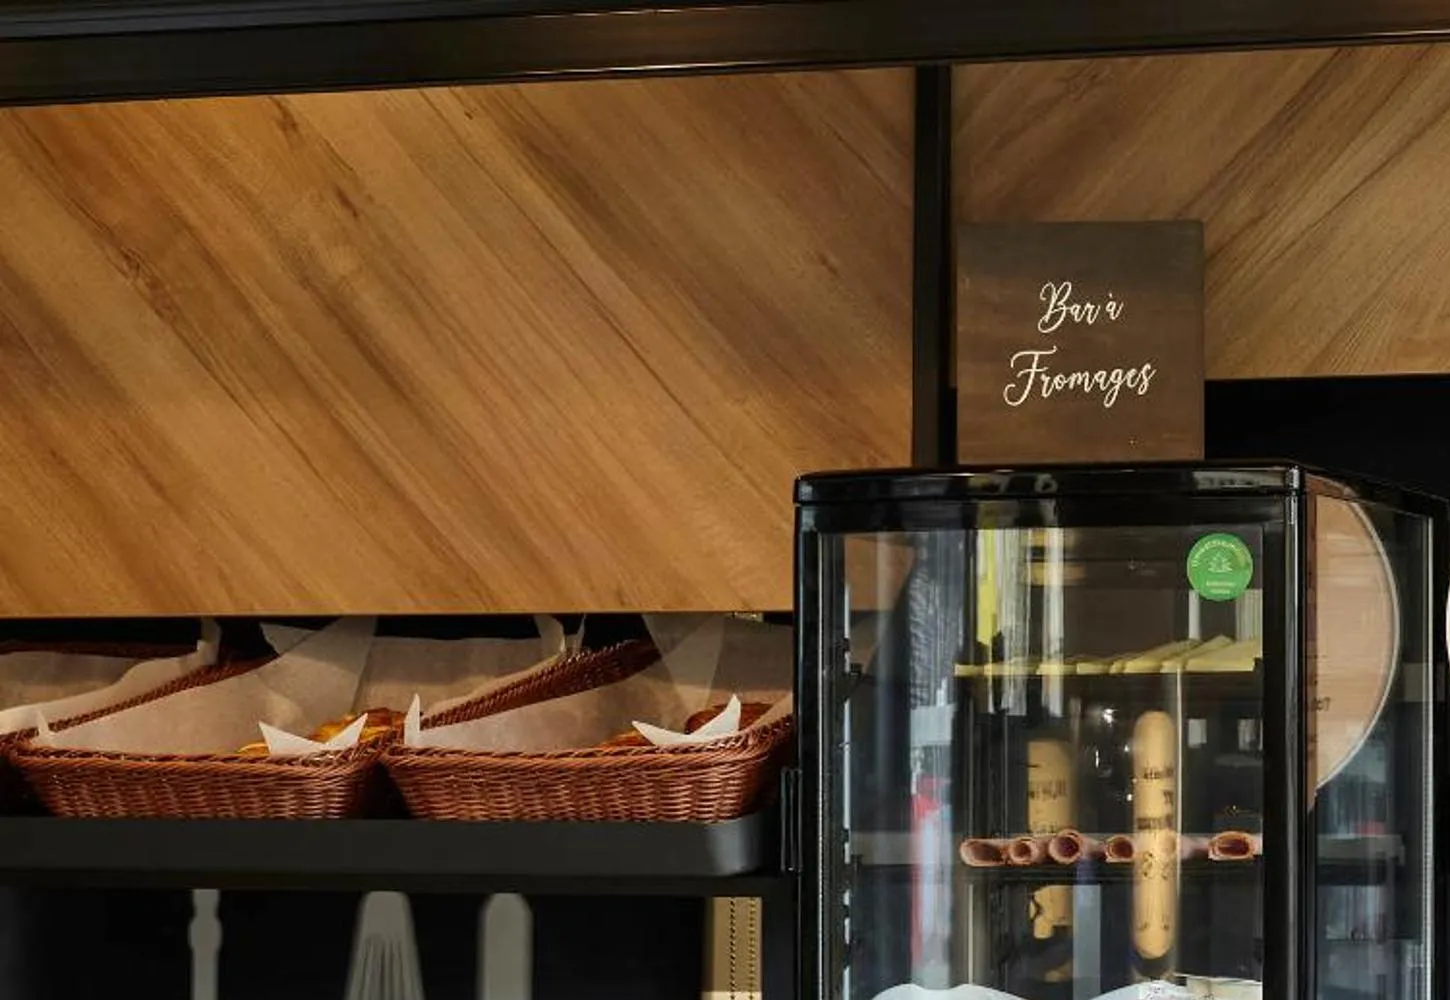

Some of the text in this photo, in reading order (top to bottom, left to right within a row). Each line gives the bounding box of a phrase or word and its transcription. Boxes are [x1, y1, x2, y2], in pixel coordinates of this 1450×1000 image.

[1038, 281, 1124, 333] Bar à
[1003, 345, 1157, 408] Fromages
